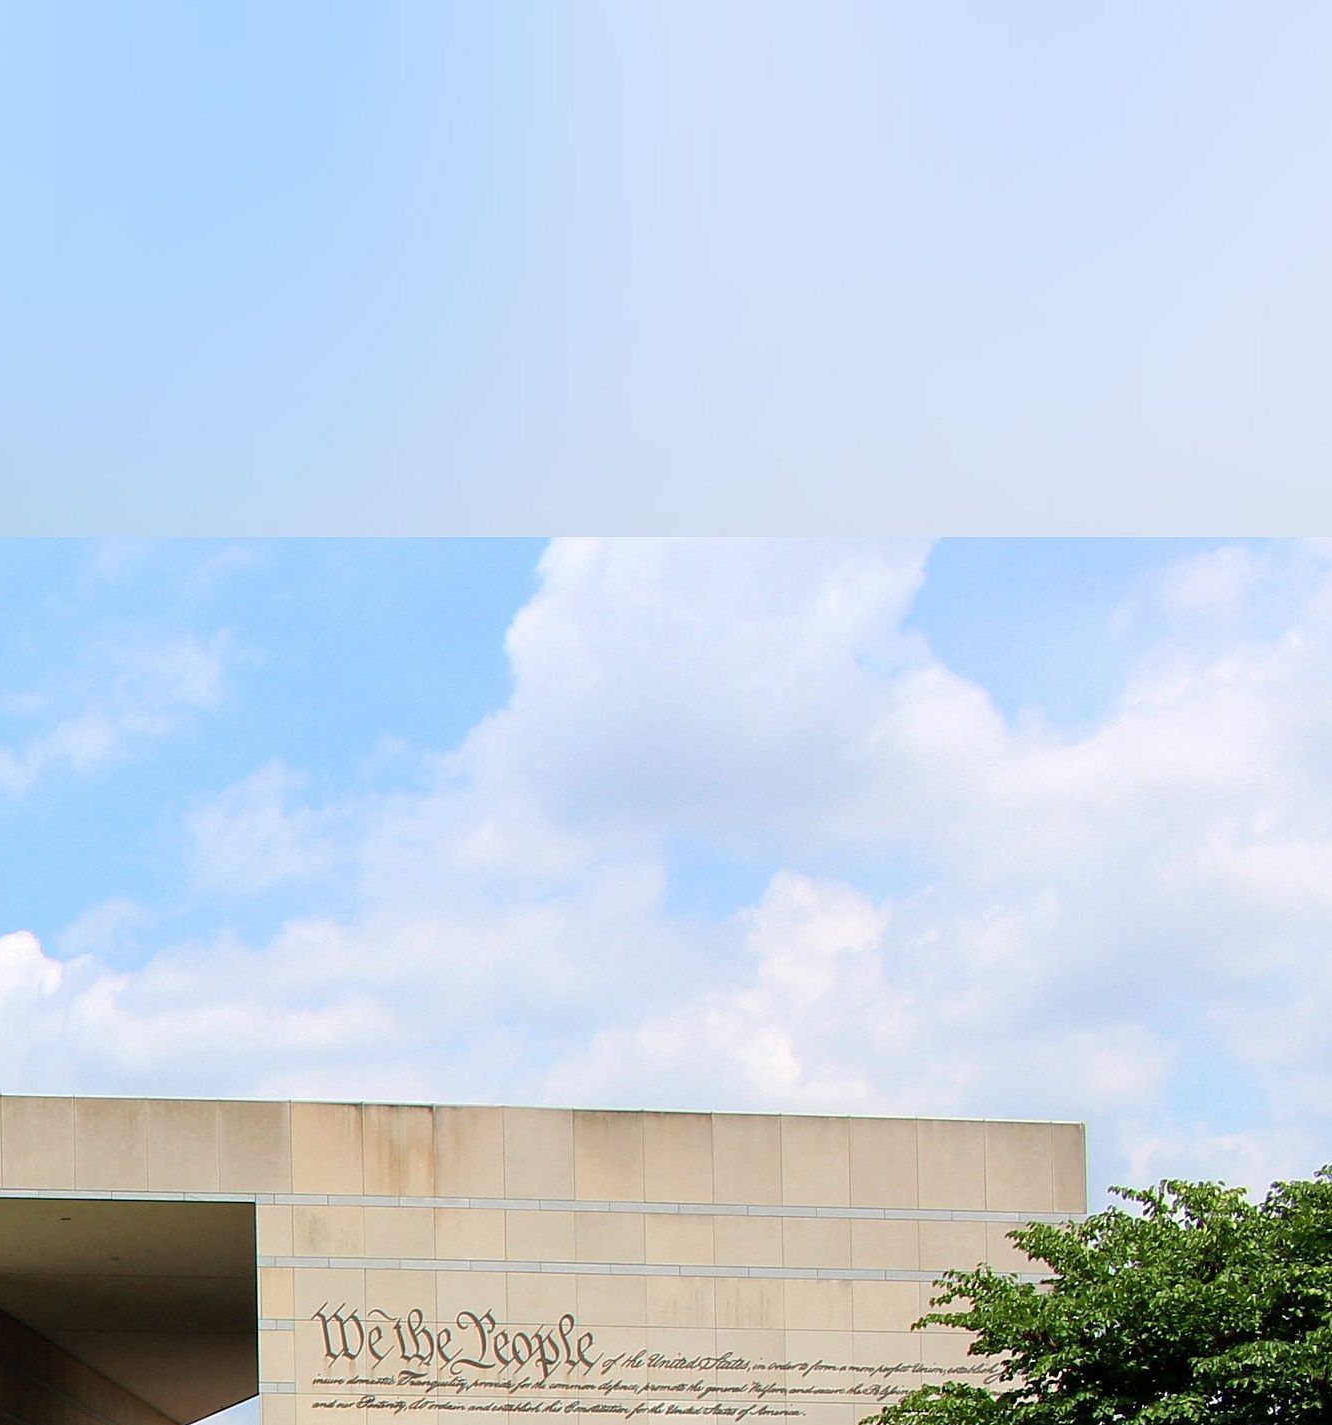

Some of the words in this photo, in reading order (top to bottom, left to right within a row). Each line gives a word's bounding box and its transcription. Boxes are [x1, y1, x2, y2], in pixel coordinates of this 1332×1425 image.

[311, 1302, 395, 1369] We
[393, 1308, 462, 1370] the
[450, 1308, 604, 1379] People
[601, 1353, 626, 1375] of
[622, 1350, 647, 1369] the
[647, 1353, 701, 1369] United
[699, 1352, 752, 1372] States,
[752, 1358, 766, 1370] in
[802, 1360, 839, 1377] form
[869, 1362, 912, 1378] perfect
[947, 1363, 999, 1374] establish
[346, 1375, 395, 1386] domestic
[396, 1370, 469, 1394] Tranquility,
[469, 1377, 513, 1390] provide
[509, 1377, 532, 1394] for
[531, 1378, 547, 1389] the
[548, 1382, 597, 1390] common
[636, 1382, 686, 1395] promote
[686, 1379, 704, 1391] the
[697, 1384, 748, 1399] general
[789, 1386, 814, 1394] and
[813, 1387, 845, 1395] secure
[845, 1383, 865, 1395] the
[312, 1400, 337, 1408] and
[356, 1395, 408, 1415] Posterity,
[428, 1401, 465, 1411] ordain
[468, 1402, 495, 1411] and
[491, 1401, 542, 1413] establish
[541, 1400, 563, 1412] this
[564, 1401, 630, 1414] Constitution
[625, 1403, 648, 1419] for
[648, 1402, 665, 1414] the
[665, 1404, 704, 1415] United
[703, 1403, 739, 1415] States
[735, 1404, 757, 1422] of
